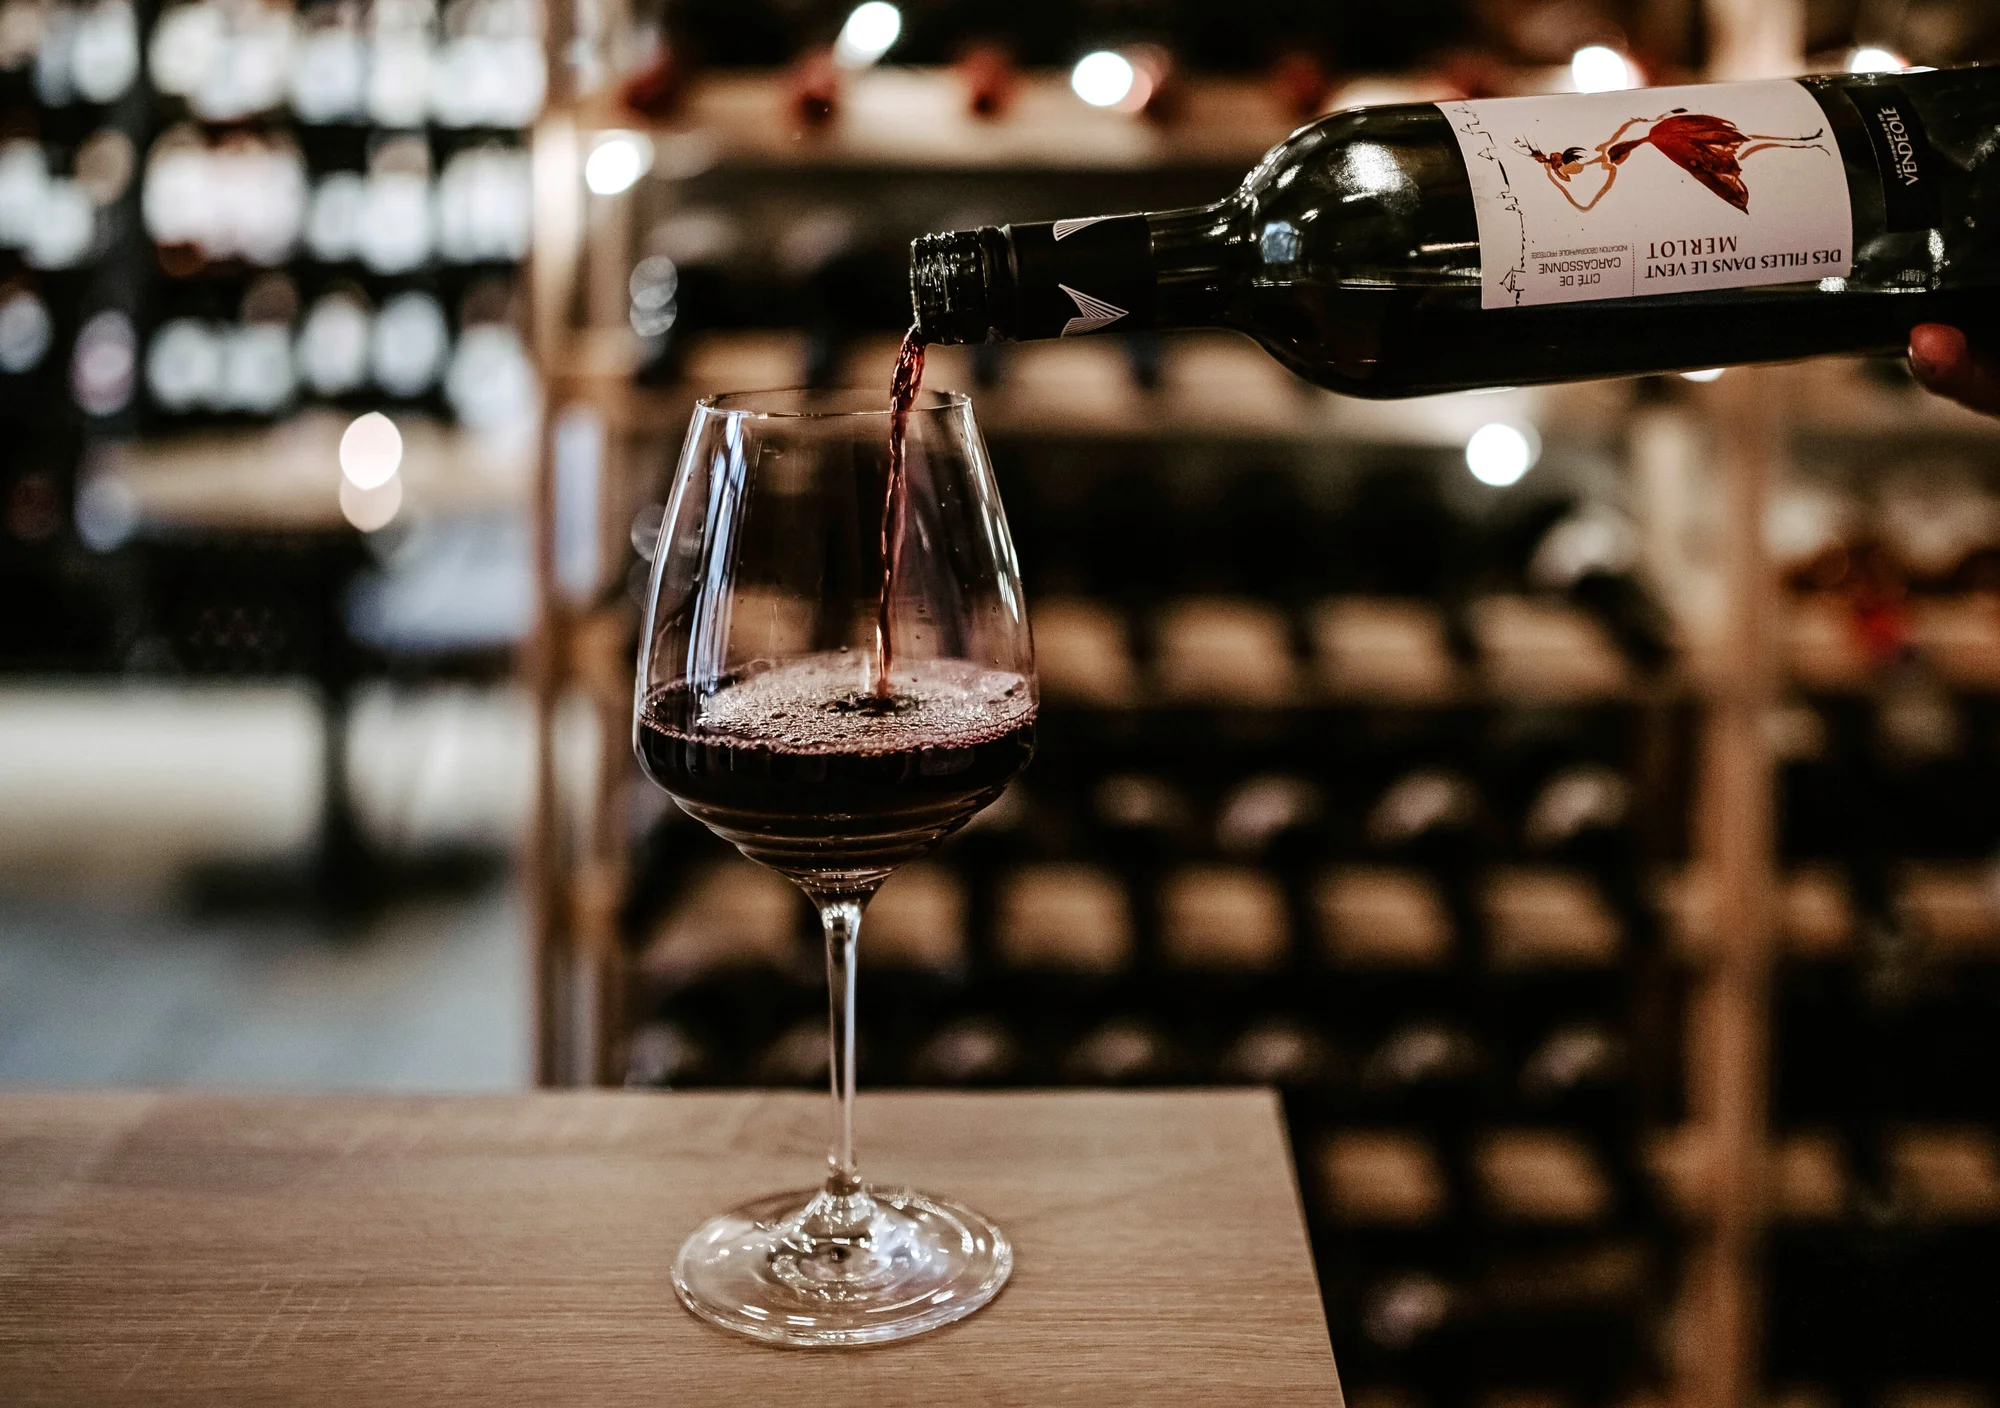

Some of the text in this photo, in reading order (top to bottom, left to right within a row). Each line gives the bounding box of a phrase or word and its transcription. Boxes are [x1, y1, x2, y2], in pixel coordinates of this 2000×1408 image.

[1599, 245, 1628, 253] INDICATION
[1646, 236, 1738, 260] MERLOT
[1538, 257, 1622, 275] CARCASSONNE
[1644, 249, 1842, 279] DES FILLES DANS LE VENT
[1559, 273, 1601, 287] CITÉ DE
